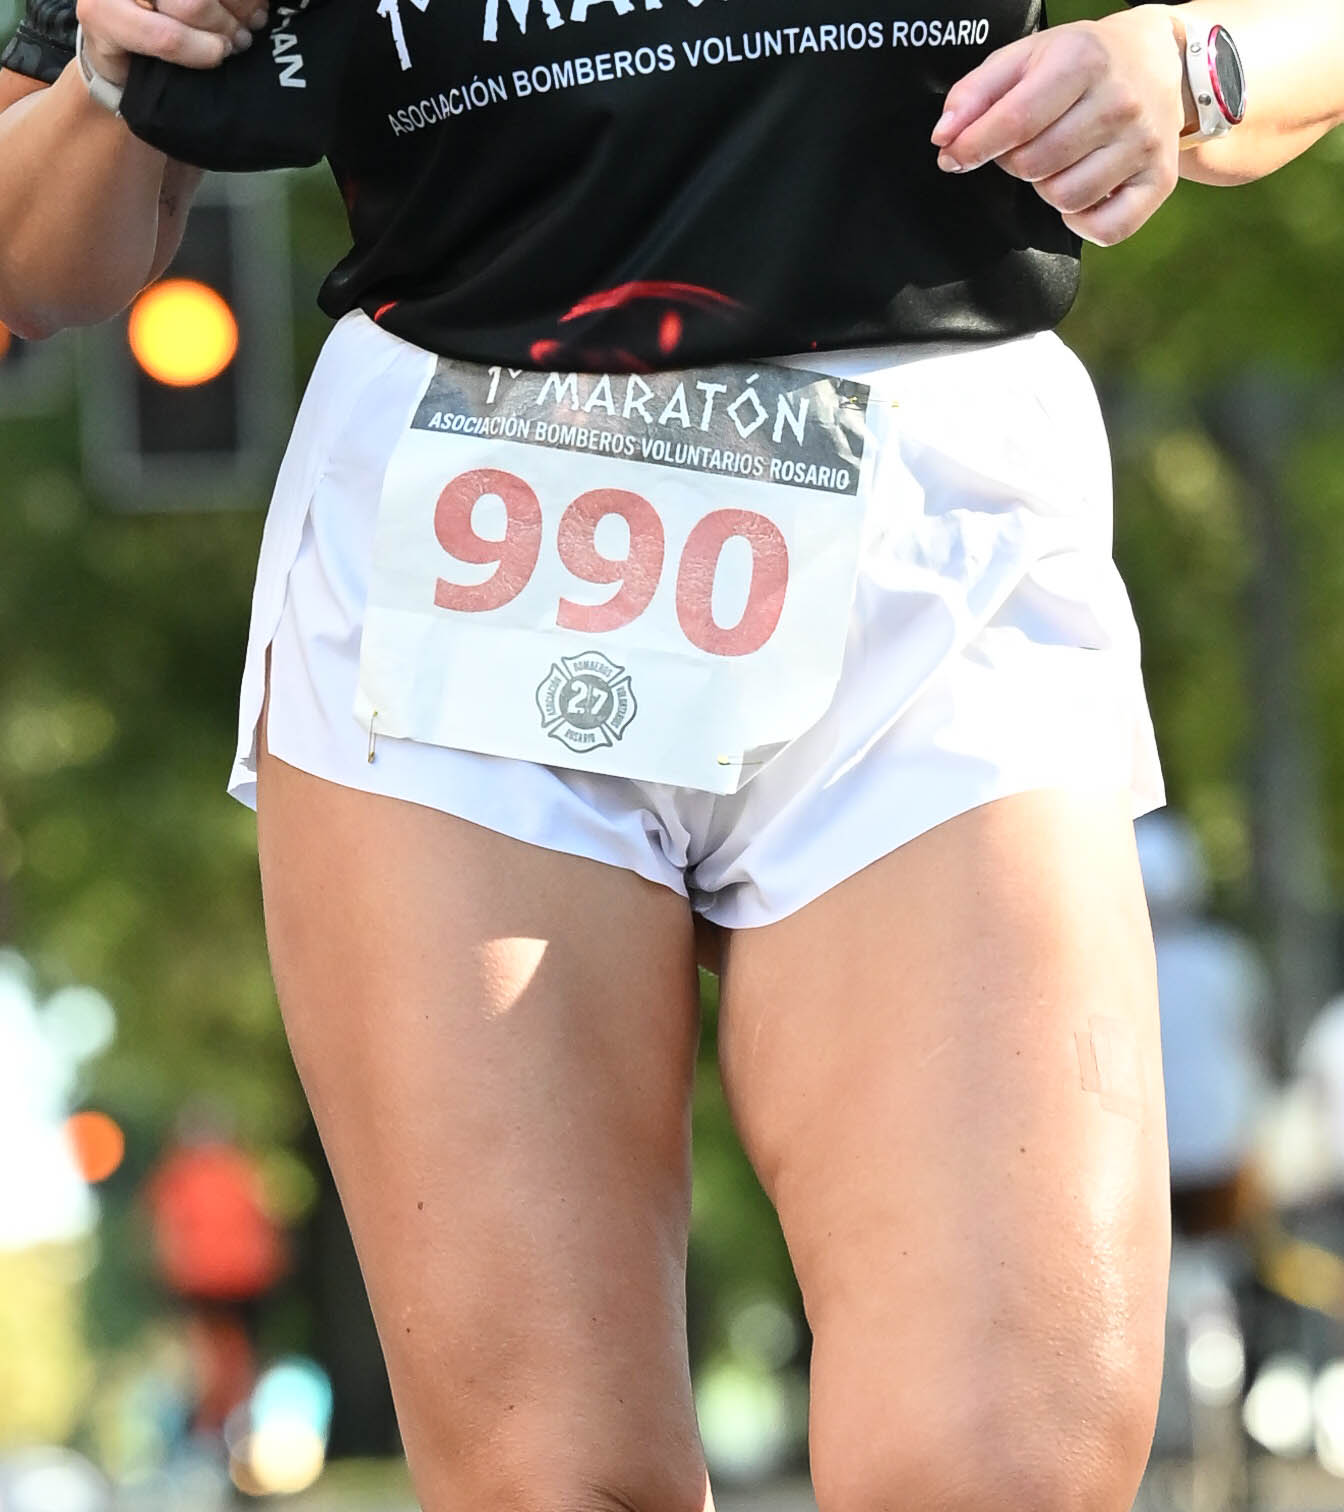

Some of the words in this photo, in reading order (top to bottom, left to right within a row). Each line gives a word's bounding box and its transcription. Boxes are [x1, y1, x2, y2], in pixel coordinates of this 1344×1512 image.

[387, 75, 508, 137] ASOCIACIÓN
[512, 43, 676, 97] BOMBEROS
[682, 21, 884, 68] VOLUNTARIOS
[892, 18, 989, 47] ROSARIO
[536, 371, 810, 448] MARATÓN
[428, 410, 531, 439] ASOCIACIÓN
[535, 422, 636, 456] BOMBEROS
[641, 437, 764, 477] VOLUNTARIOS
[769, 457, 851, 490] ROSARIO
[432, 468, 790, 658] 990
[567, 680, 609, 715] 27
